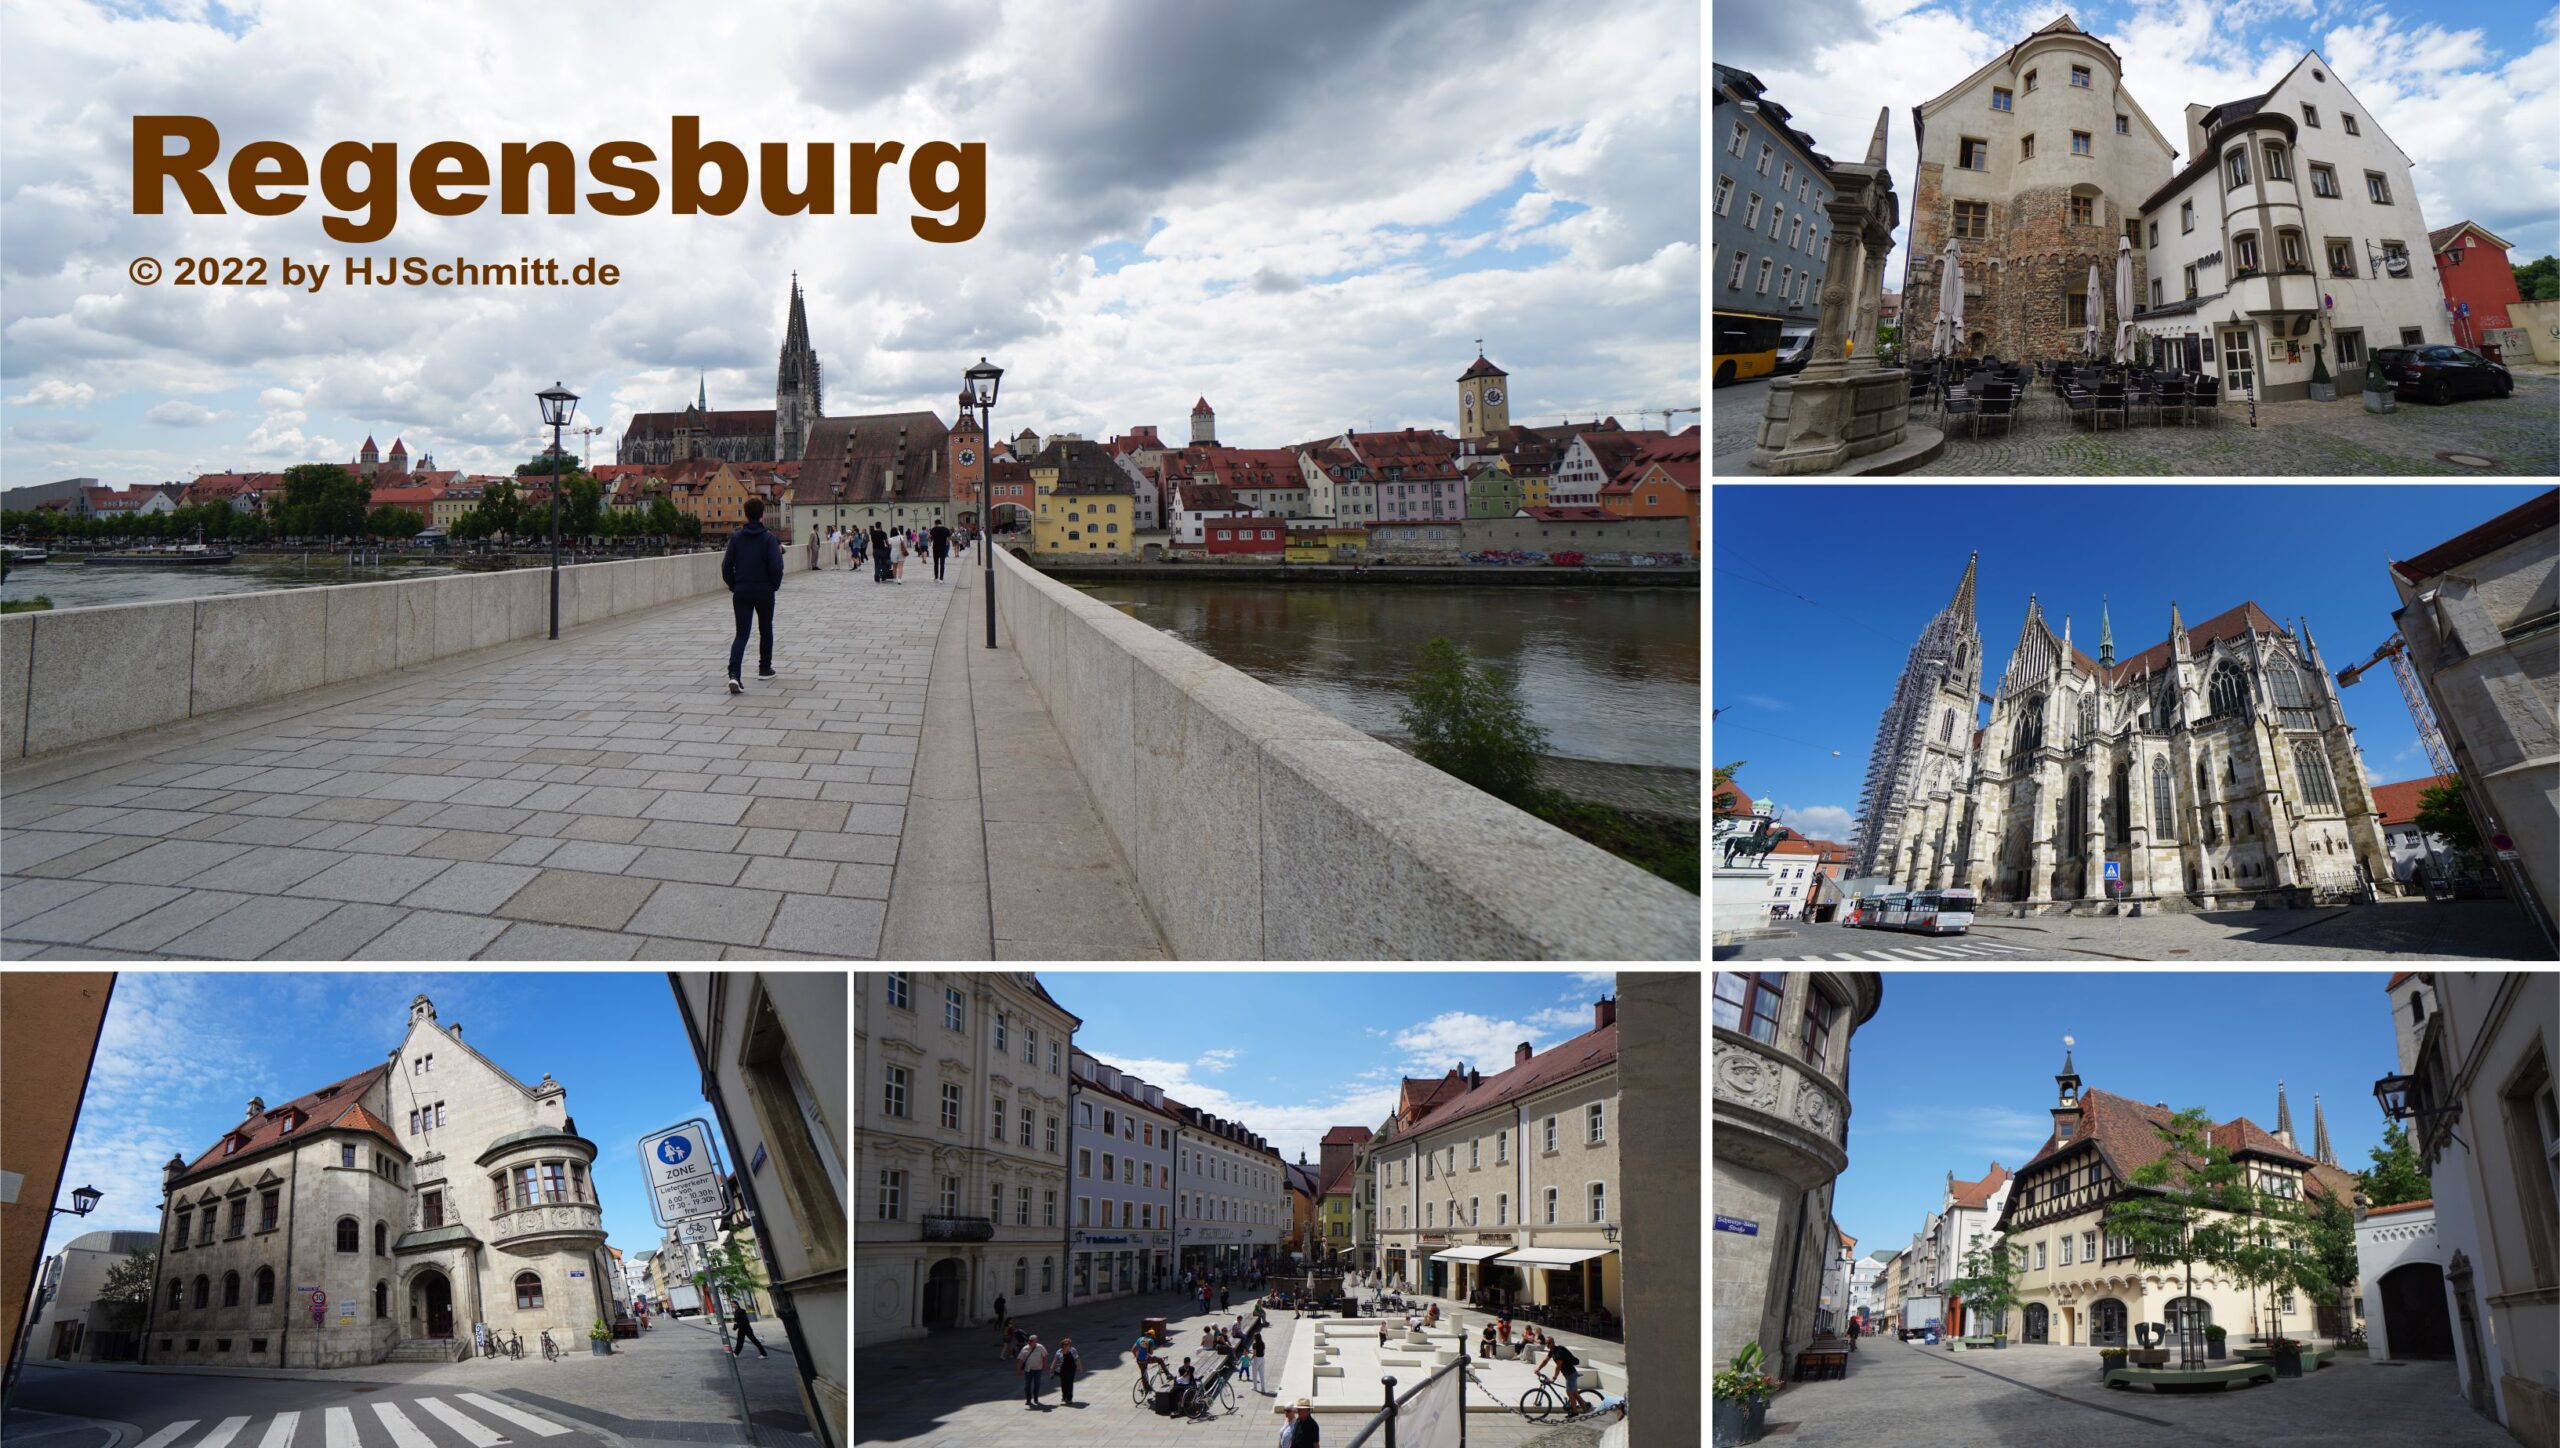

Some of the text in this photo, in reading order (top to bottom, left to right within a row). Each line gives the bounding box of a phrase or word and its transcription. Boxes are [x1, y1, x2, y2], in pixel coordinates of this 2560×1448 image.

[665, 1164, 696, 1180] ZONE
[660, 1177, 709, 1195] Lieferverkehr
[679, 1187, 693, 1195] von
[684, 1207, 698, 1215] frei
[314, 1293, 324, 1301] 30
